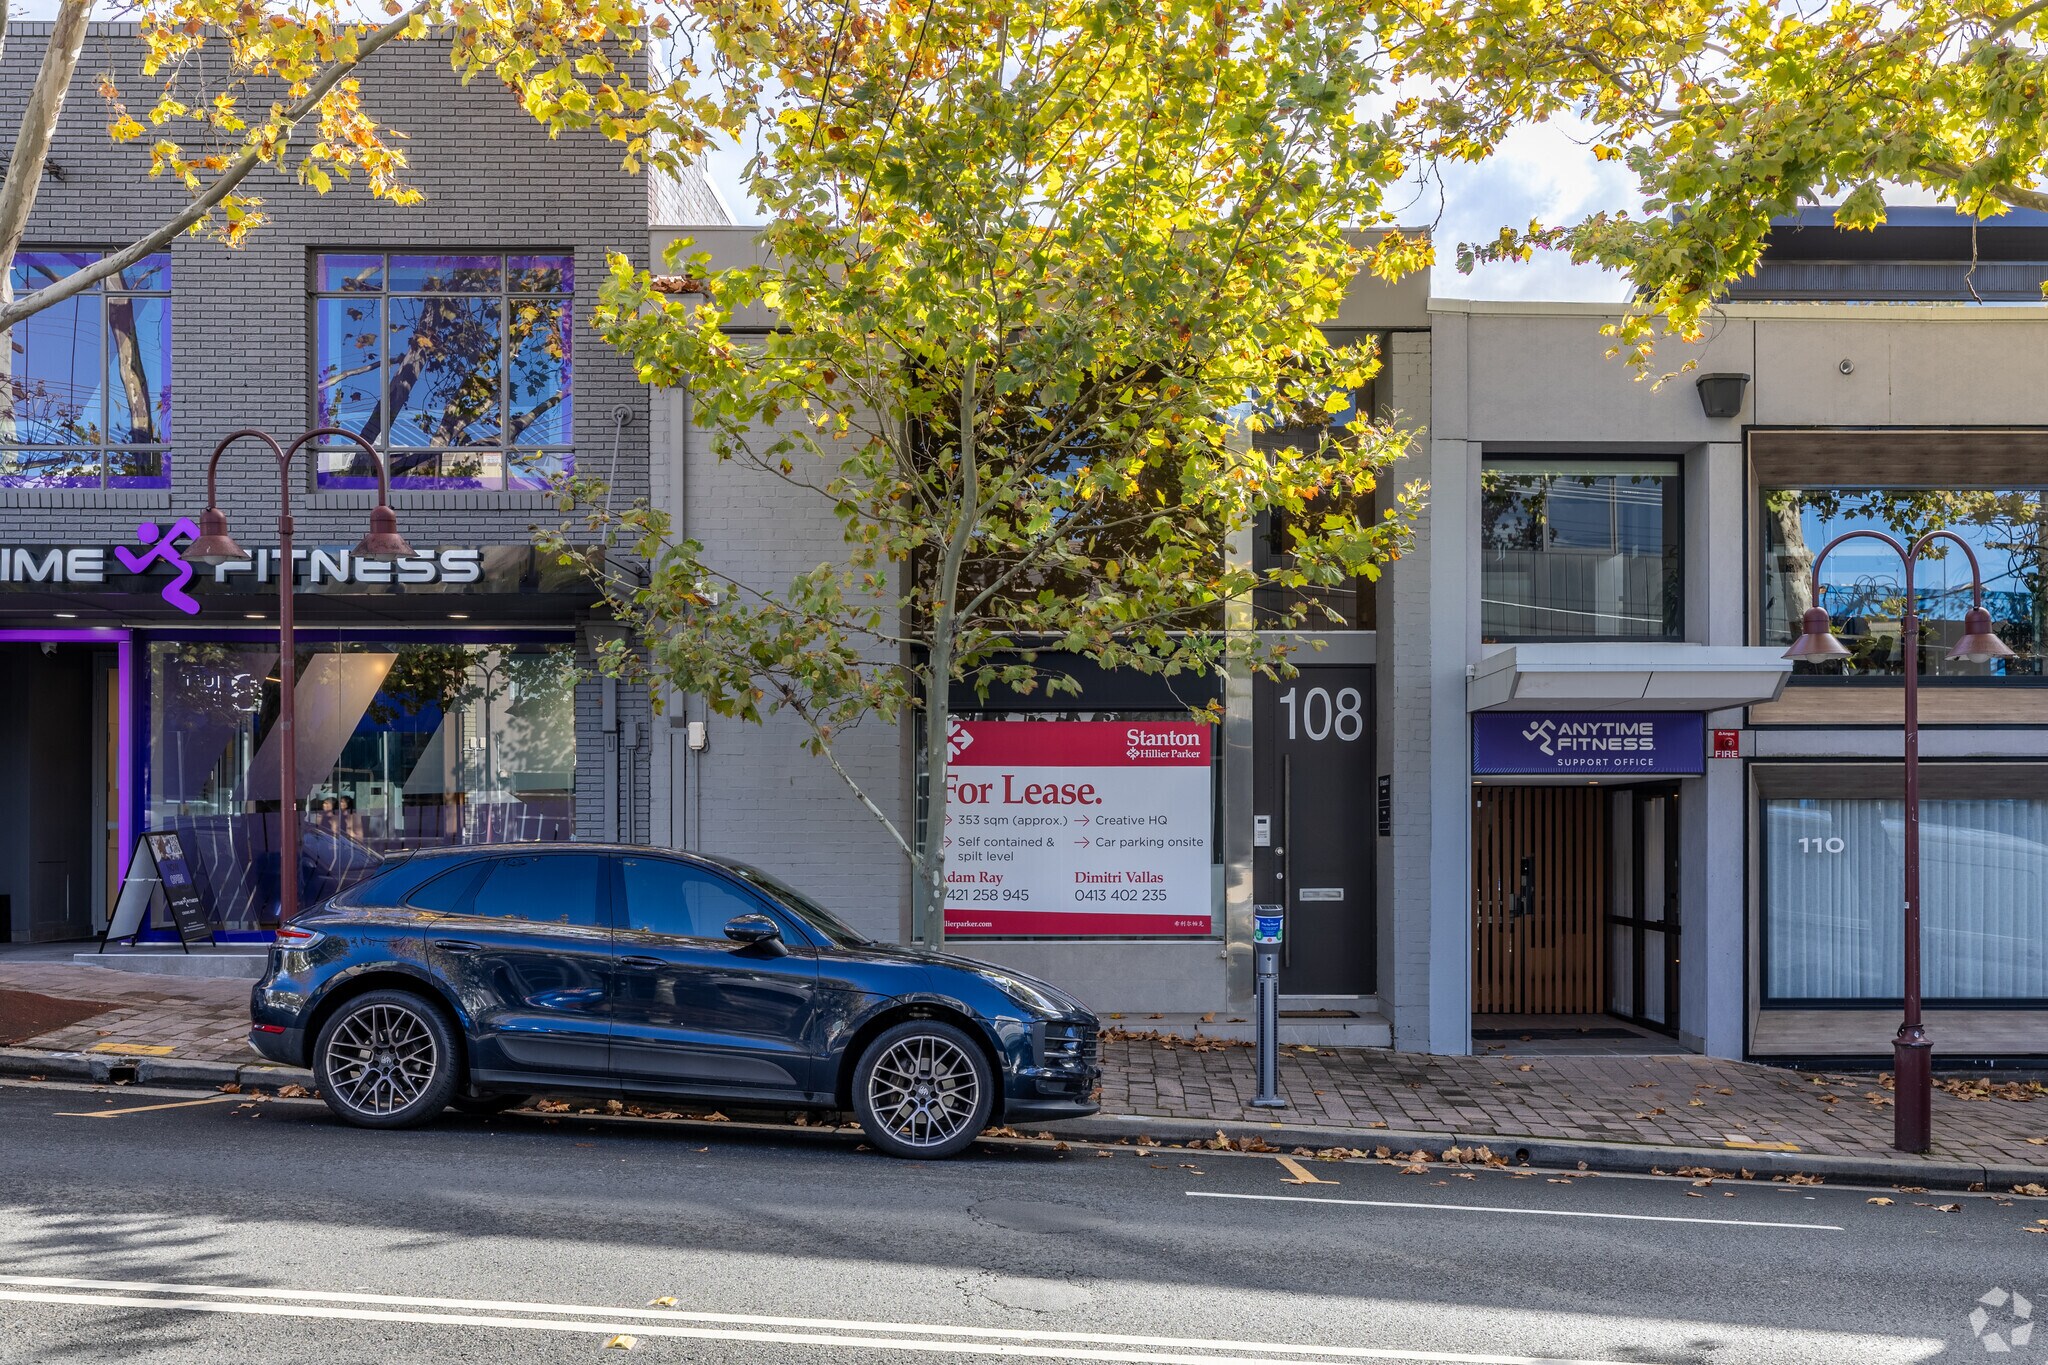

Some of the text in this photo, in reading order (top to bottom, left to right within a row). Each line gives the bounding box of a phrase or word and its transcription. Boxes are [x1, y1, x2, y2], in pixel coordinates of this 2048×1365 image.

[1279, 687, 1363, 742] 108
[1557, 722, 1654, 736] ANYTIME
[1126, 728, 1201, 746] Stanton
[1557, 737, 1655, 751] FITNESS
[1140, 749, 1201, 758] Hillier Parker
[1715, 750, 1738, 758] FIRE
[1557, 758, 1654, 767] SUPPORT OFFICE
[946, 774, 1103, 805] For Lease.
[958, 814, 1068, 827] 353 sqm (approx.)
[1095, 815, 1168, 826] Creative HQ
[958, 836, 1055, 848] Self contained &
[1095, 836, 1204, 850] Car parking onsite
[1798, 837, 1845, 853] 110
[958, 851, 1014, 863] spilt level
[944, 871, 1004, 887] dam Ray
[1074, 871, 1164, 884] Dimitri Vallas
[946, 888, 1030, 902] 421 258 945
[1074, 889, 1168, 902] 0413 402 235
[945, 920, 993, 929] lierparker.com
